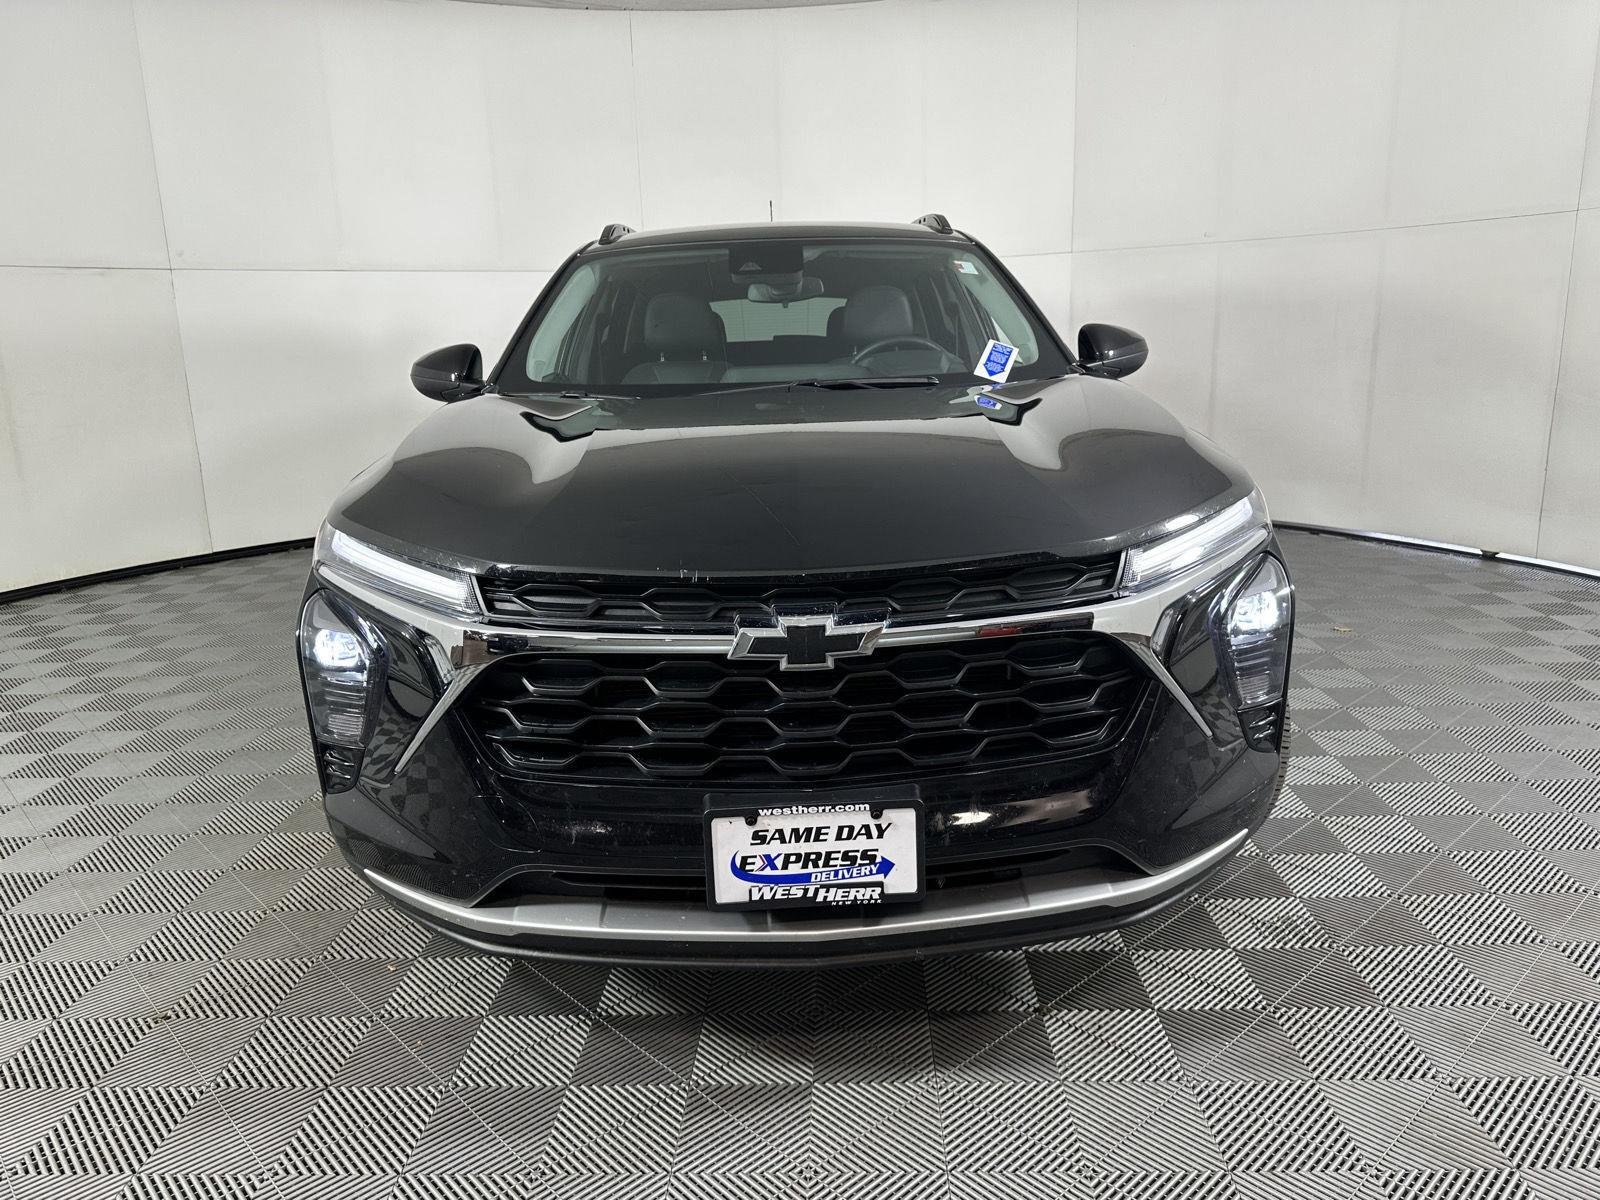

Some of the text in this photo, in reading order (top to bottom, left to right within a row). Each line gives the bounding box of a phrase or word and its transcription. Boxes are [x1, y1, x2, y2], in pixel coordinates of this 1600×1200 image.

[758, 803, 870, 816] westherr.com
[750, 822, 893, 846] SAME DAY
[738, 848, 879, 873] EXPRESS
[810, 864, 880, 883] DELIVERY
